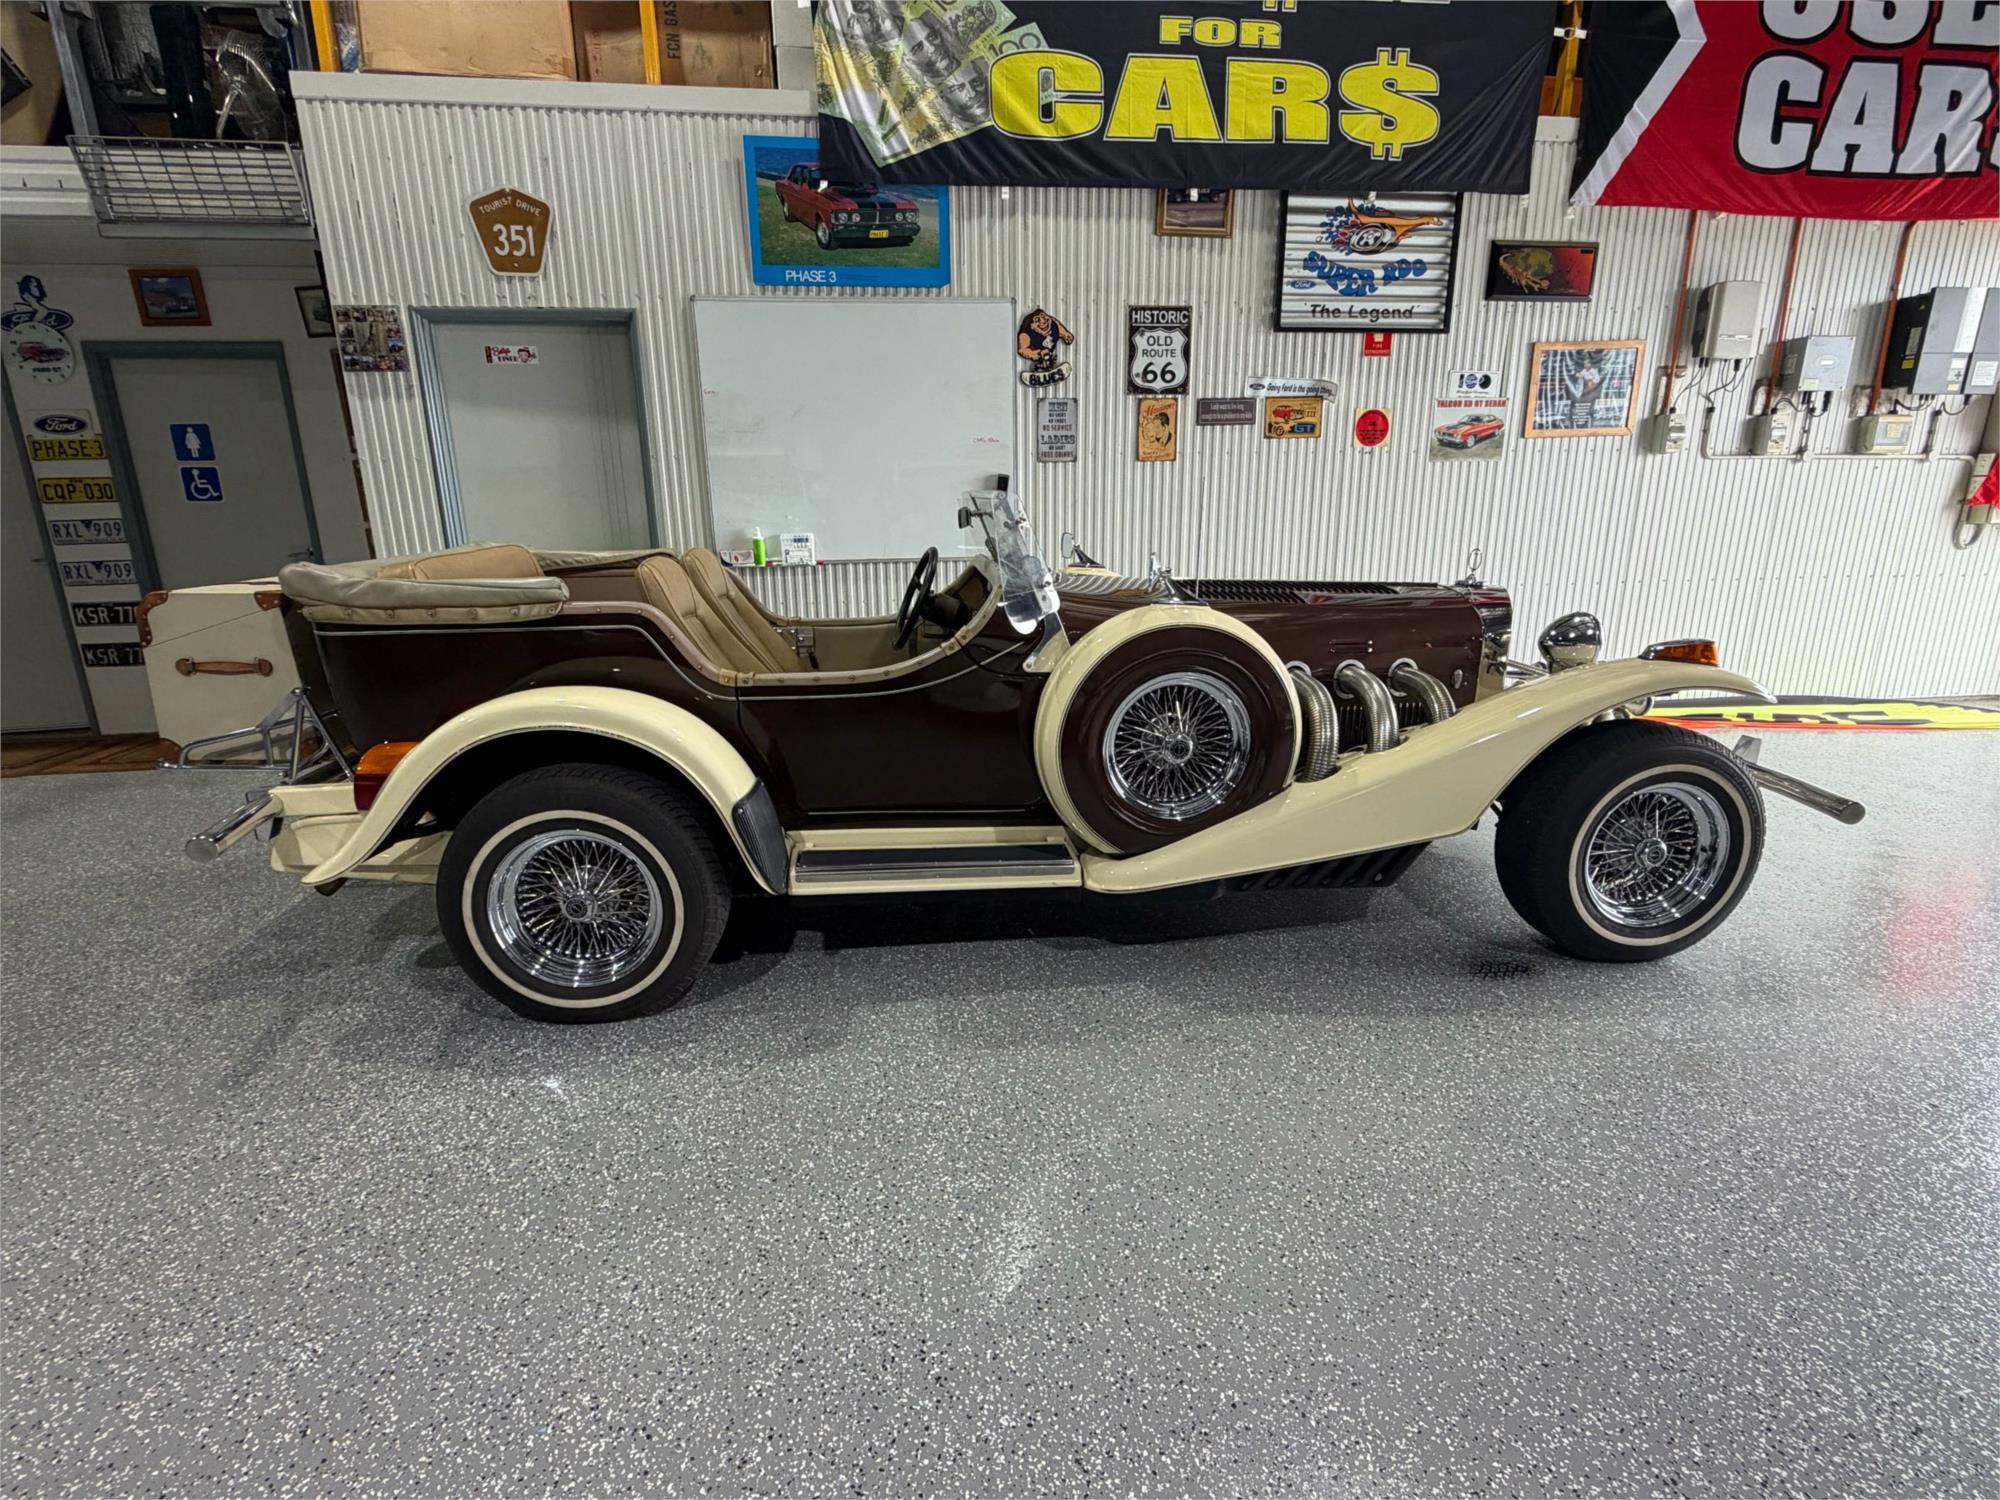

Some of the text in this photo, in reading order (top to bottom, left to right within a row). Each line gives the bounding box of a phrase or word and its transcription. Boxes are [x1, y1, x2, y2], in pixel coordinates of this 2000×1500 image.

[1159, 15, 1283, 49] FOR
[989, 47, 1441, 162] CAR$
[1733, 49, 2000, 179] CAR
[479, 196, 542, 217] TOURIST DRIVE
[492, 223, 536, 257] 351
[785, 270, 837, 283] PHASE 3
[1302, 250, 1428, 297] SUPER ROO
[1293, 280, 1312, 289] Ford
[1132, 310, 1189, 324] HISTORIC
[1146, 335, 1173, 347] OLD
[1141, 349, 1177, 358] ROUTE
[1028, 367, 1066, 387] BLUES
[1141, 361, 1176, 384] 66
[1266, 382, 1281, 394] Going
[1281, 383, 1293, 392] Ford
[1305, 386, 1320, 396] going
[1437, 400, 1463, 408] FALCON
[44, 417, 78, 431] Ford
[1293, 424, 1315, 433] GT
[1040, 434, 1075, 443] LADIES
[52, 521, 123, 539] RXL 909
[62, 561, 132, 581] RXL 909
[86, 648, 118, 666] KSR
